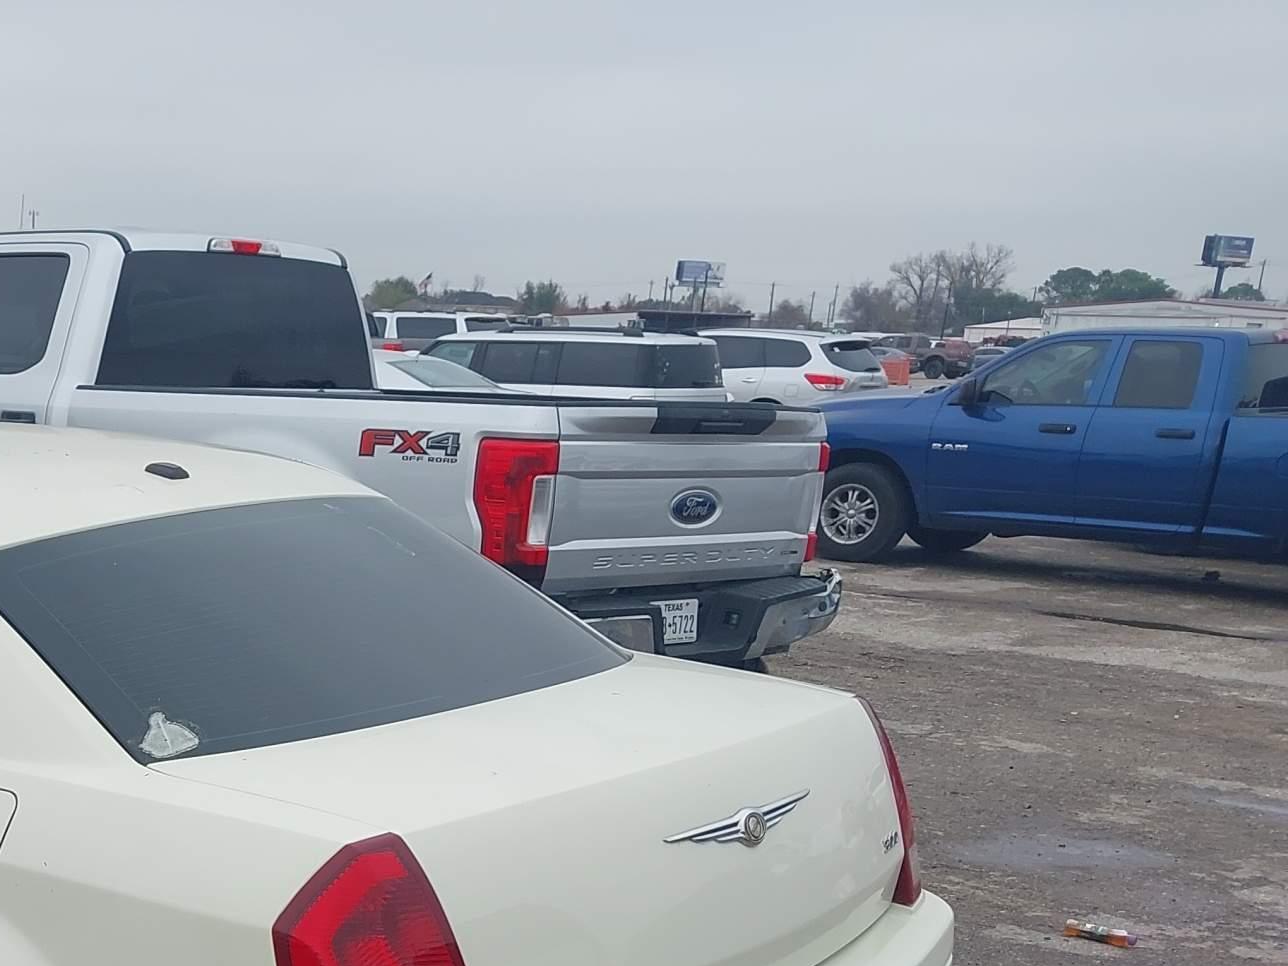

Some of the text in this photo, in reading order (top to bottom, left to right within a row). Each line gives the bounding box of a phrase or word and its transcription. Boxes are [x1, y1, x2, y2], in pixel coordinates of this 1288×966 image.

[358, 428, 461, 457] FX4
[427, 456, 458, 464] ROAD
[682, 496, 712, 517] Ford
[592, 546, 776, 570] SUPER DUTY
[664, 602, 684, 613] TEXAS
